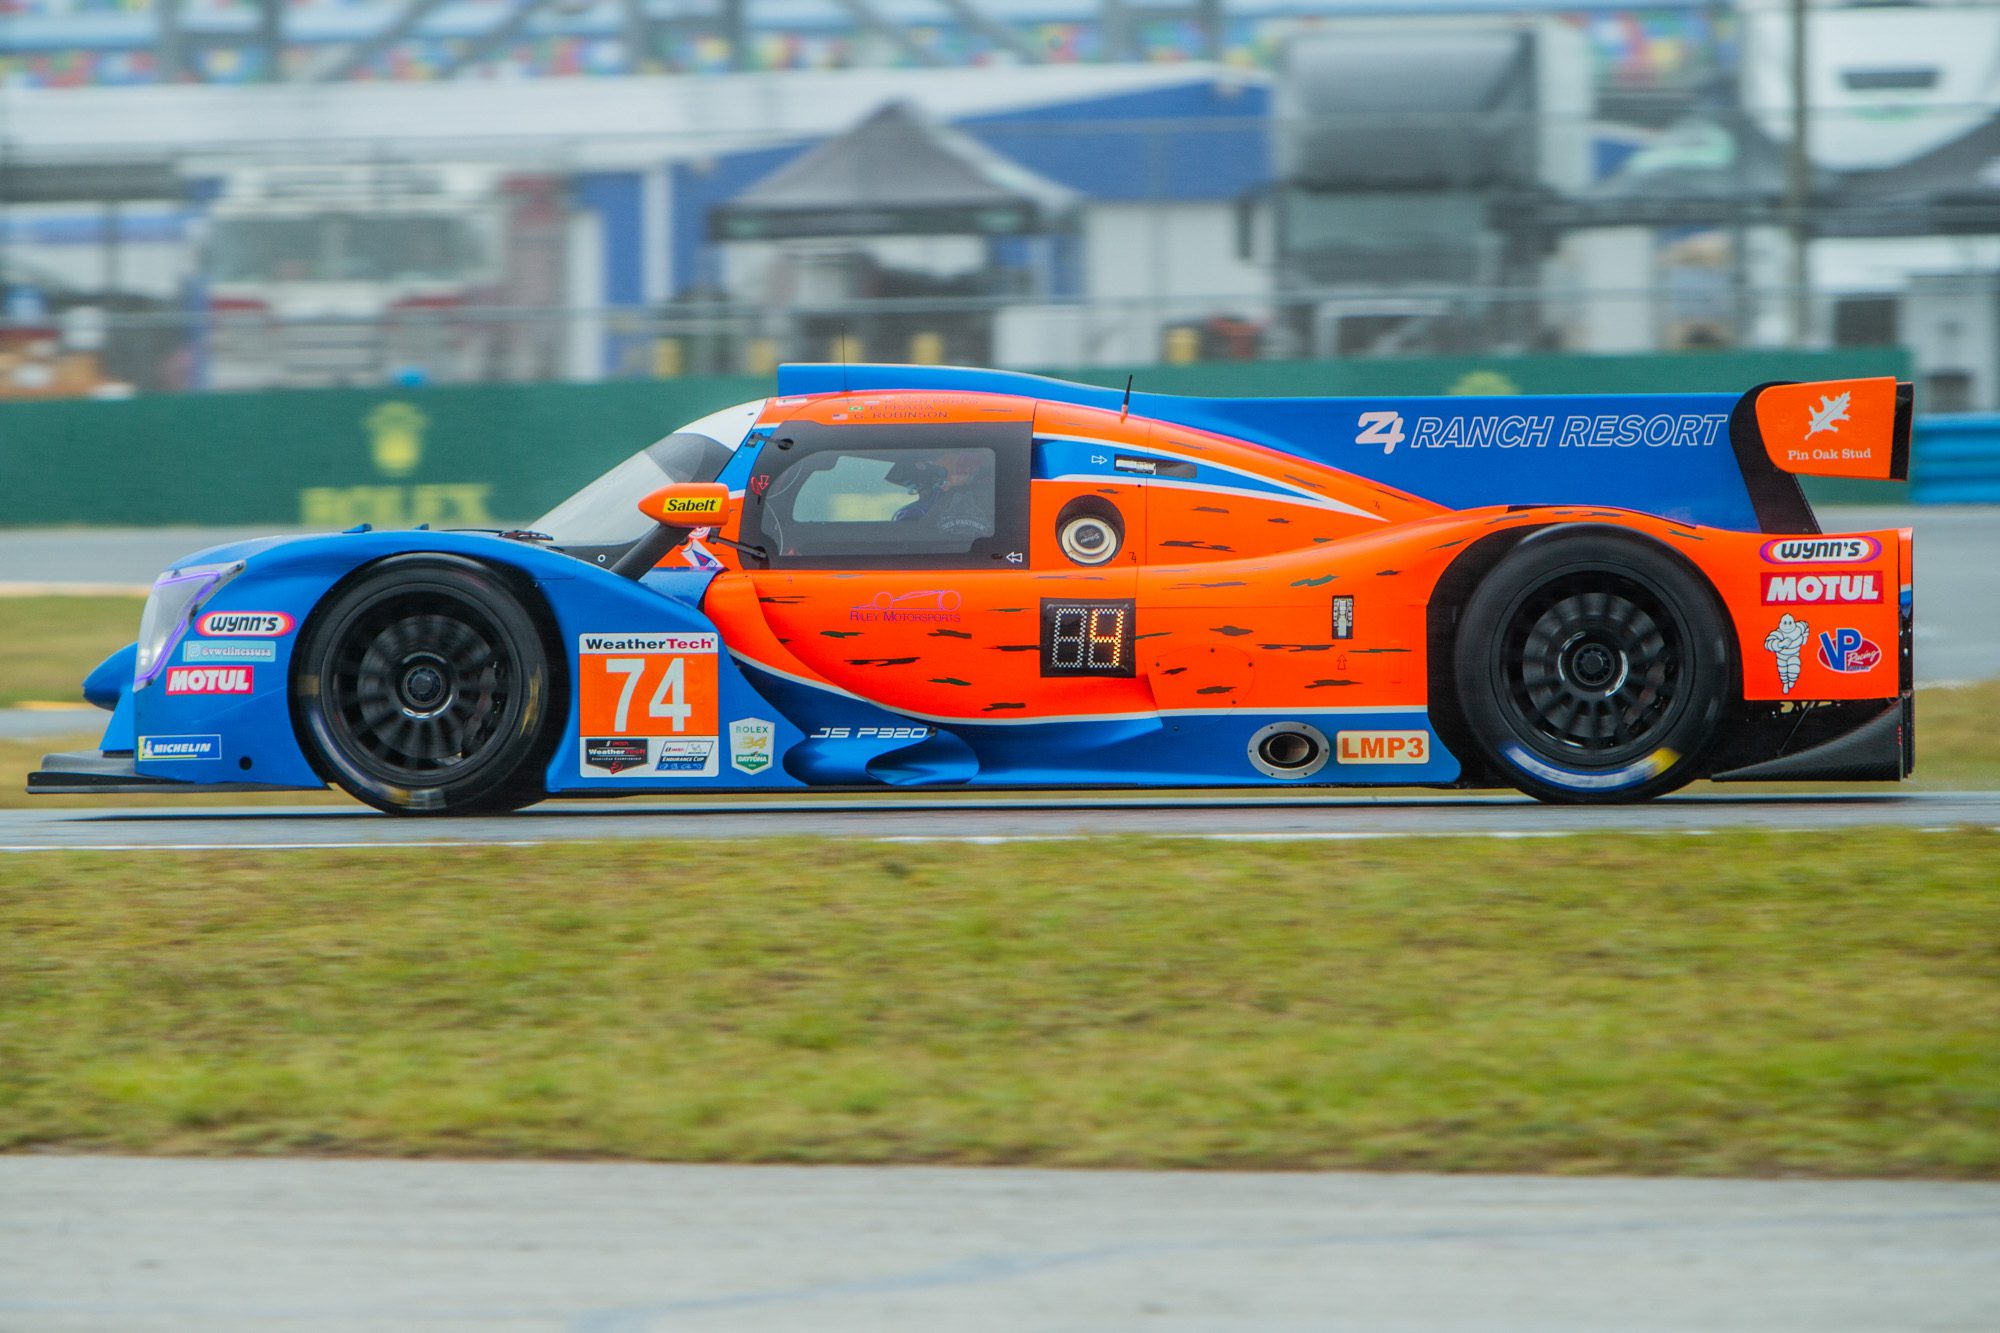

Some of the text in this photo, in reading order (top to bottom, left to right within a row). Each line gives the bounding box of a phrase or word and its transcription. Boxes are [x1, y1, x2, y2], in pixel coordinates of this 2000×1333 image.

[872, 411, 949, 419] ROBINSON
[1411, 416, 1553, 449] RANCH
[1559, 413, 1727, 448] RESORT
[1787, 447, 1871, 461] Pin Oak Stud
[667, 499, 716, 512] Sabelt
[1766, 575, 1879, 602] MOTUL
[1819, 628, 1863, 671] VP
[168, 669, 250, 692] MOTUL
[606, 657, 692, 733] 74
[735, 726, 769, 734] ROLEX
[810, 727, 928, 739] JS P320
[153, 743, 212, 753] MICHELIN
[1341, 737, 1424, 759] LMP3
